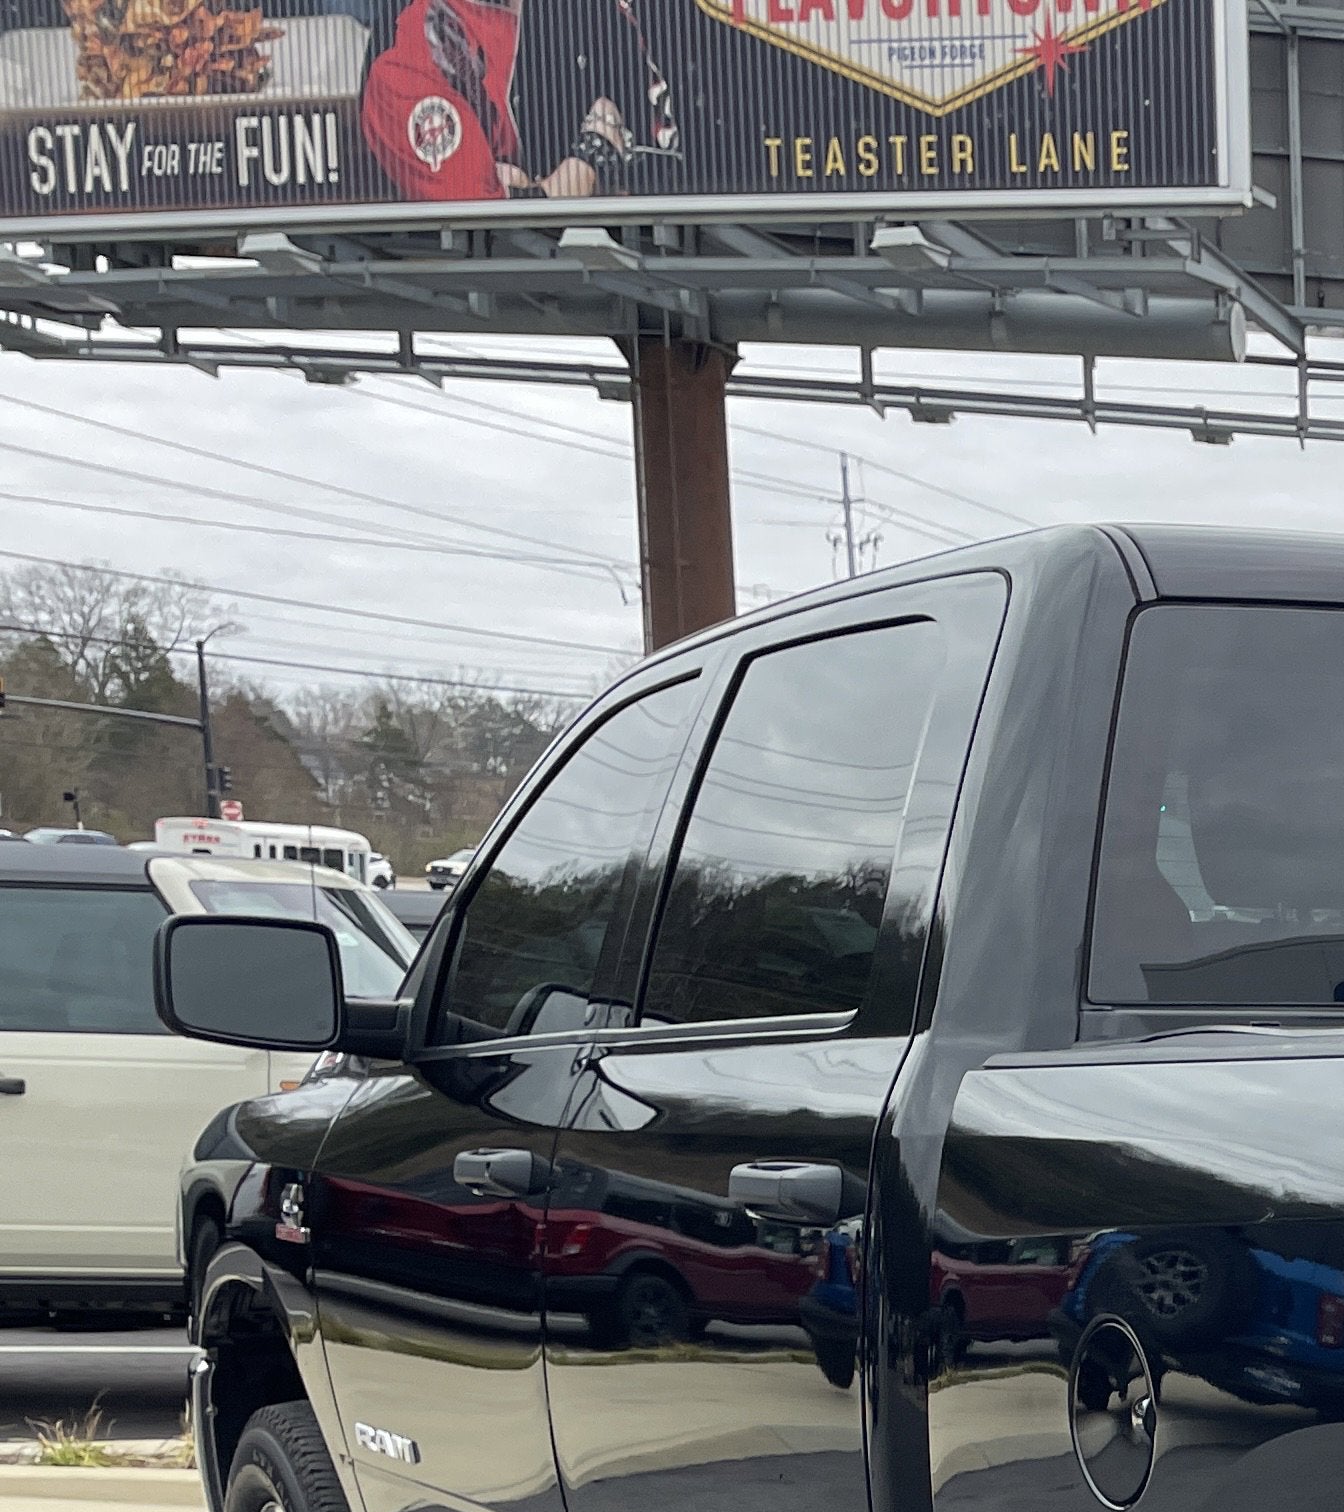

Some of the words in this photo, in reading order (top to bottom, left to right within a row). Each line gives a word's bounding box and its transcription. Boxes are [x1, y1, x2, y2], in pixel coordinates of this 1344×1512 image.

[28, 122, 136, 195] STAY
[141, 144, 179, 176] FOR
[187, 142, 225, 174] THE
[236, 112, 338, 187] FUN!
[764, 135, 974, 177] TEASTER
[1009, 130, 1130, 173] LANE
[354, 1422, 421, 1465] RAM
